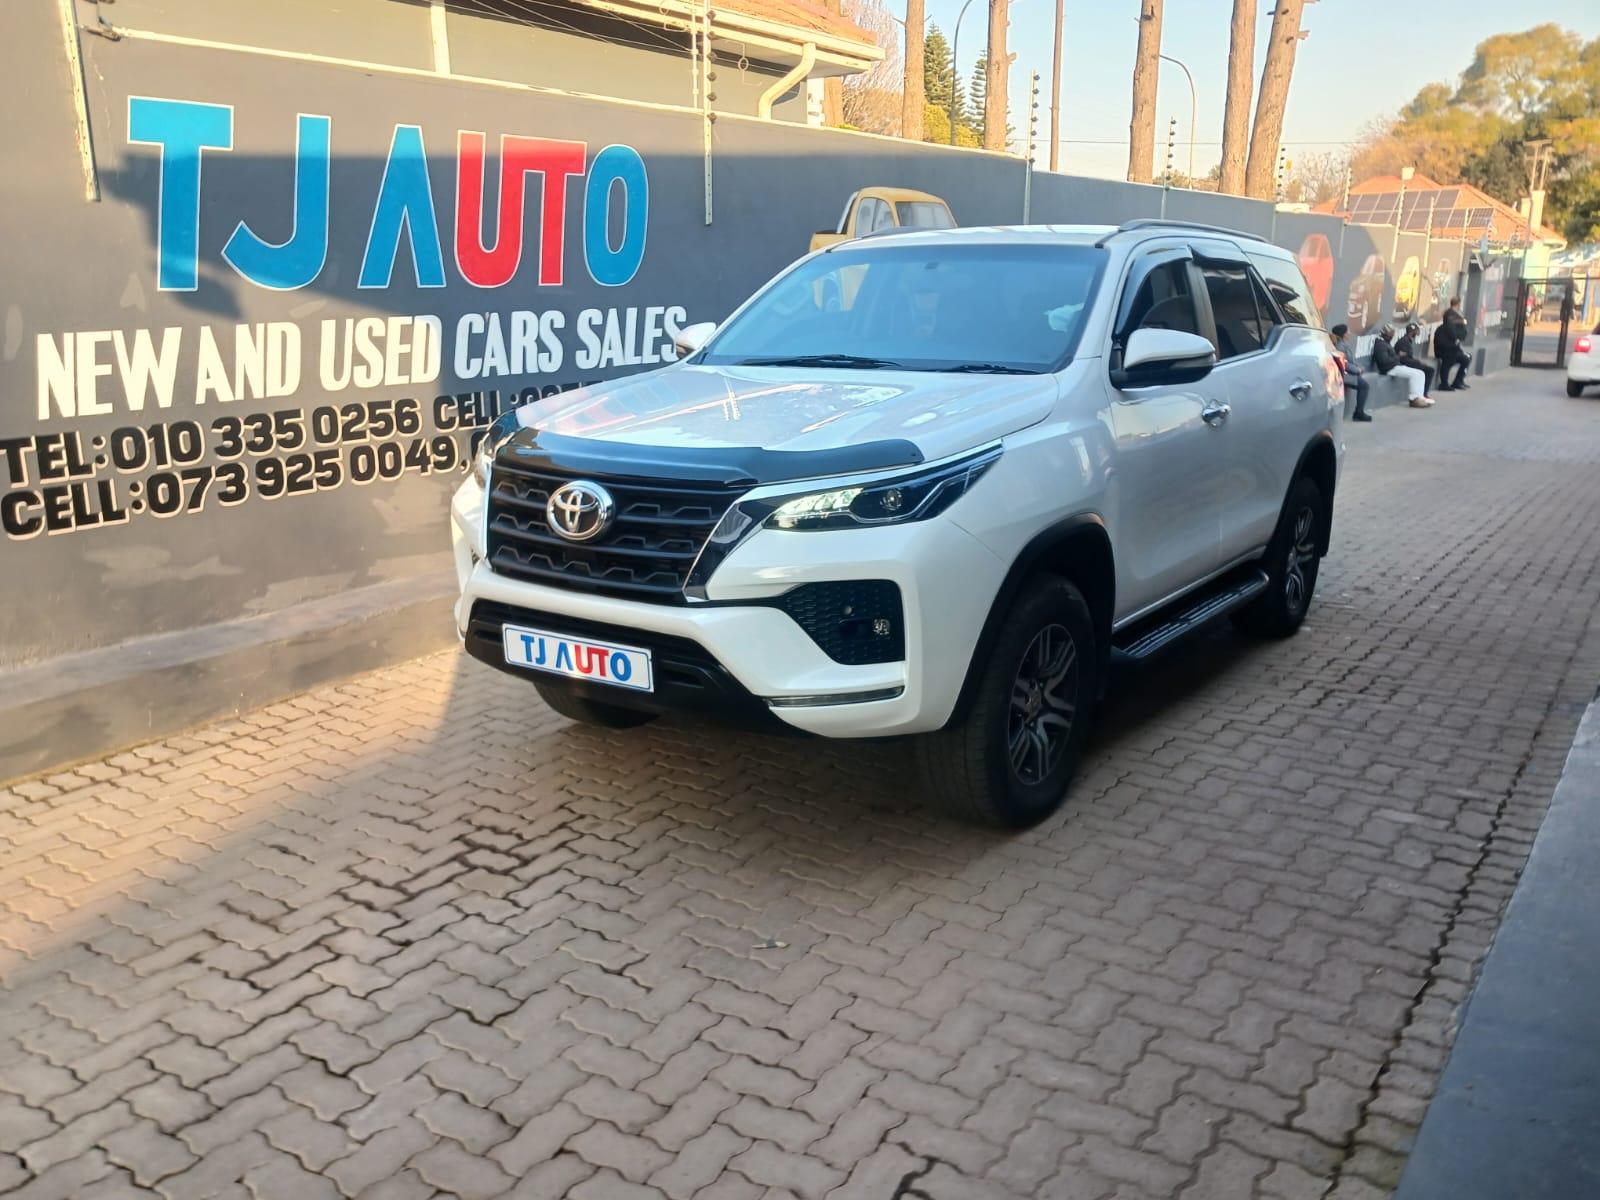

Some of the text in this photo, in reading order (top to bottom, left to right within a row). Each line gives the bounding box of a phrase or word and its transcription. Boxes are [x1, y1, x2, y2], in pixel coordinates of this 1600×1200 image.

[127, 95, 649, 292] TJ AUTO
[37, 305, 687, 421] NEW AND USED CARS SALES
[211, 408, 306, 460] 335
[312, 398, 423, 447] 0256
[255, 448, 344, 500] 925
[349, 434, 471, 485] 0049,
[520, 634, 632, 682] TJ AUTO
